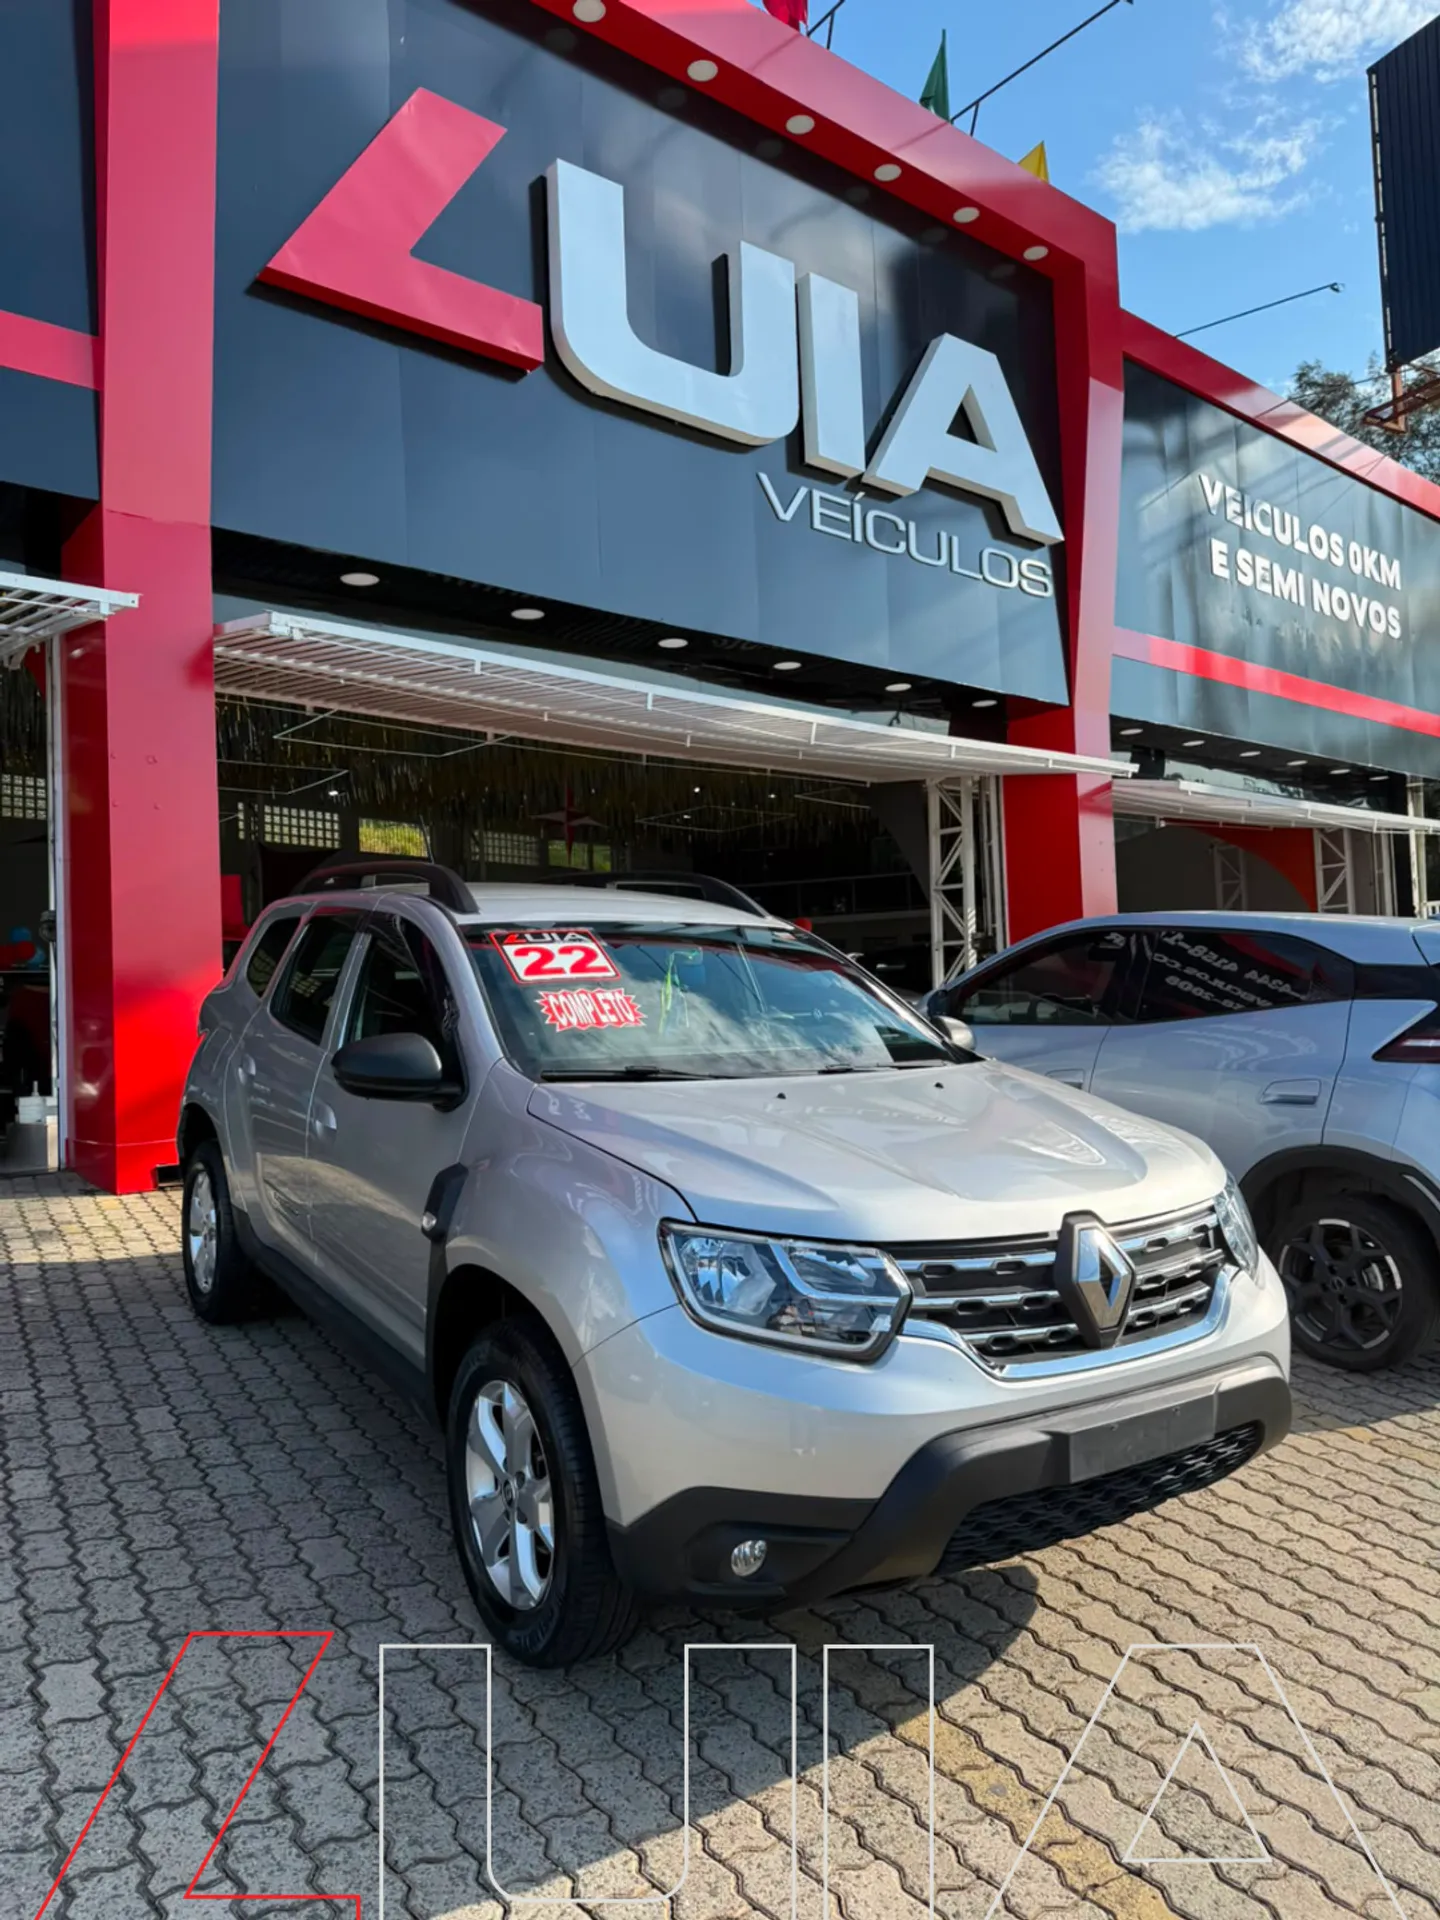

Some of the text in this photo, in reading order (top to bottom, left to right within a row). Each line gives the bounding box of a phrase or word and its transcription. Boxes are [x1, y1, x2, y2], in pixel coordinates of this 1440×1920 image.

[757, 472, 1053, 597] VEÍCULOS
[1211, 538, 1401, 639] E SEMI NOVOS
[513, 946, 610, 976] 22
[548, 991, 635, 1026] COMPLETO
